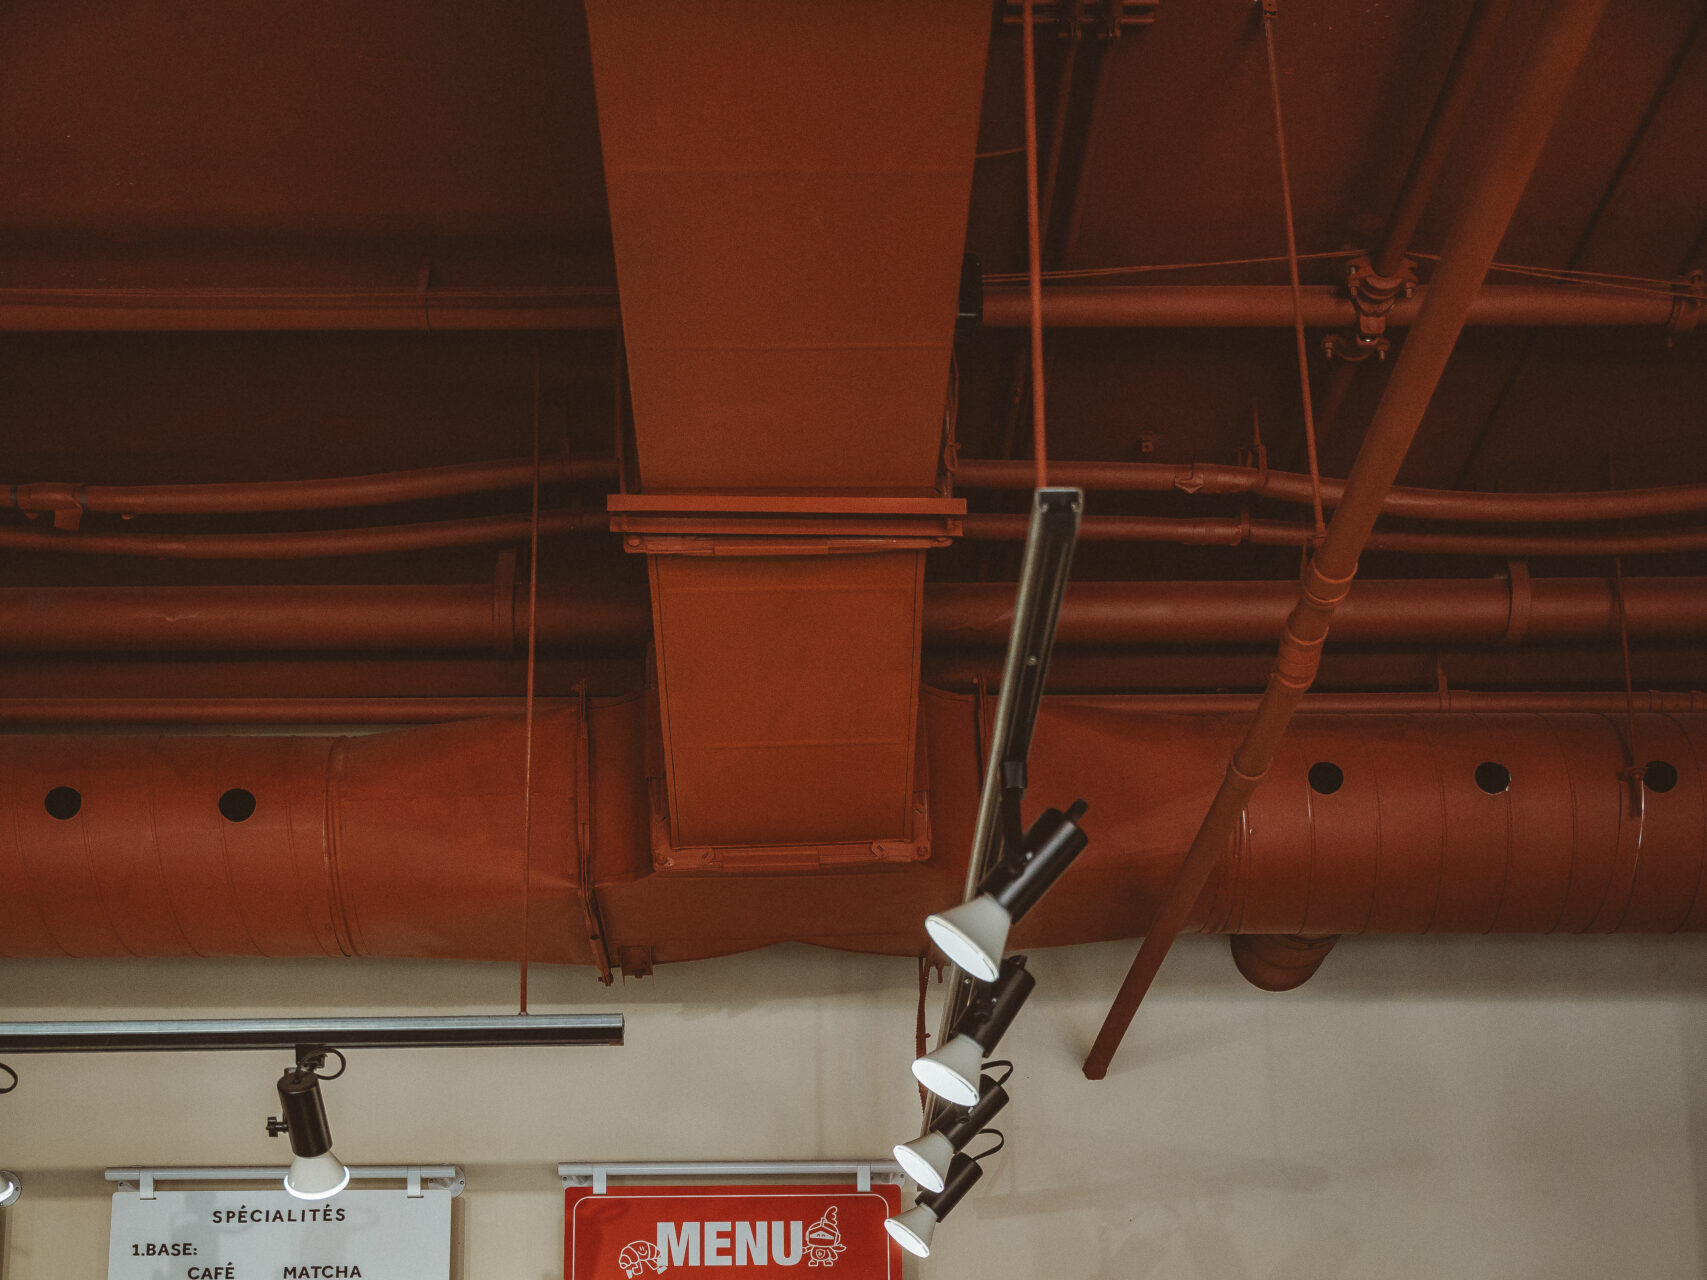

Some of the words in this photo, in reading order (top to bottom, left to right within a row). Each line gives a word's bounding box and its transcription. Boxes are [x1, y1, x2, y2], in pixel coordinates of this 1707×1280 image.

[213, 1204, 345, 1223] SPÉCIALITÉS
[133, 1243, 197, 1256] 1.BASE:
[656, 1221, 803, 1266] MENU
[188, 1262, 234, 1280] CAFÉ
[284, 1266, 361, 1279] MATCHA
